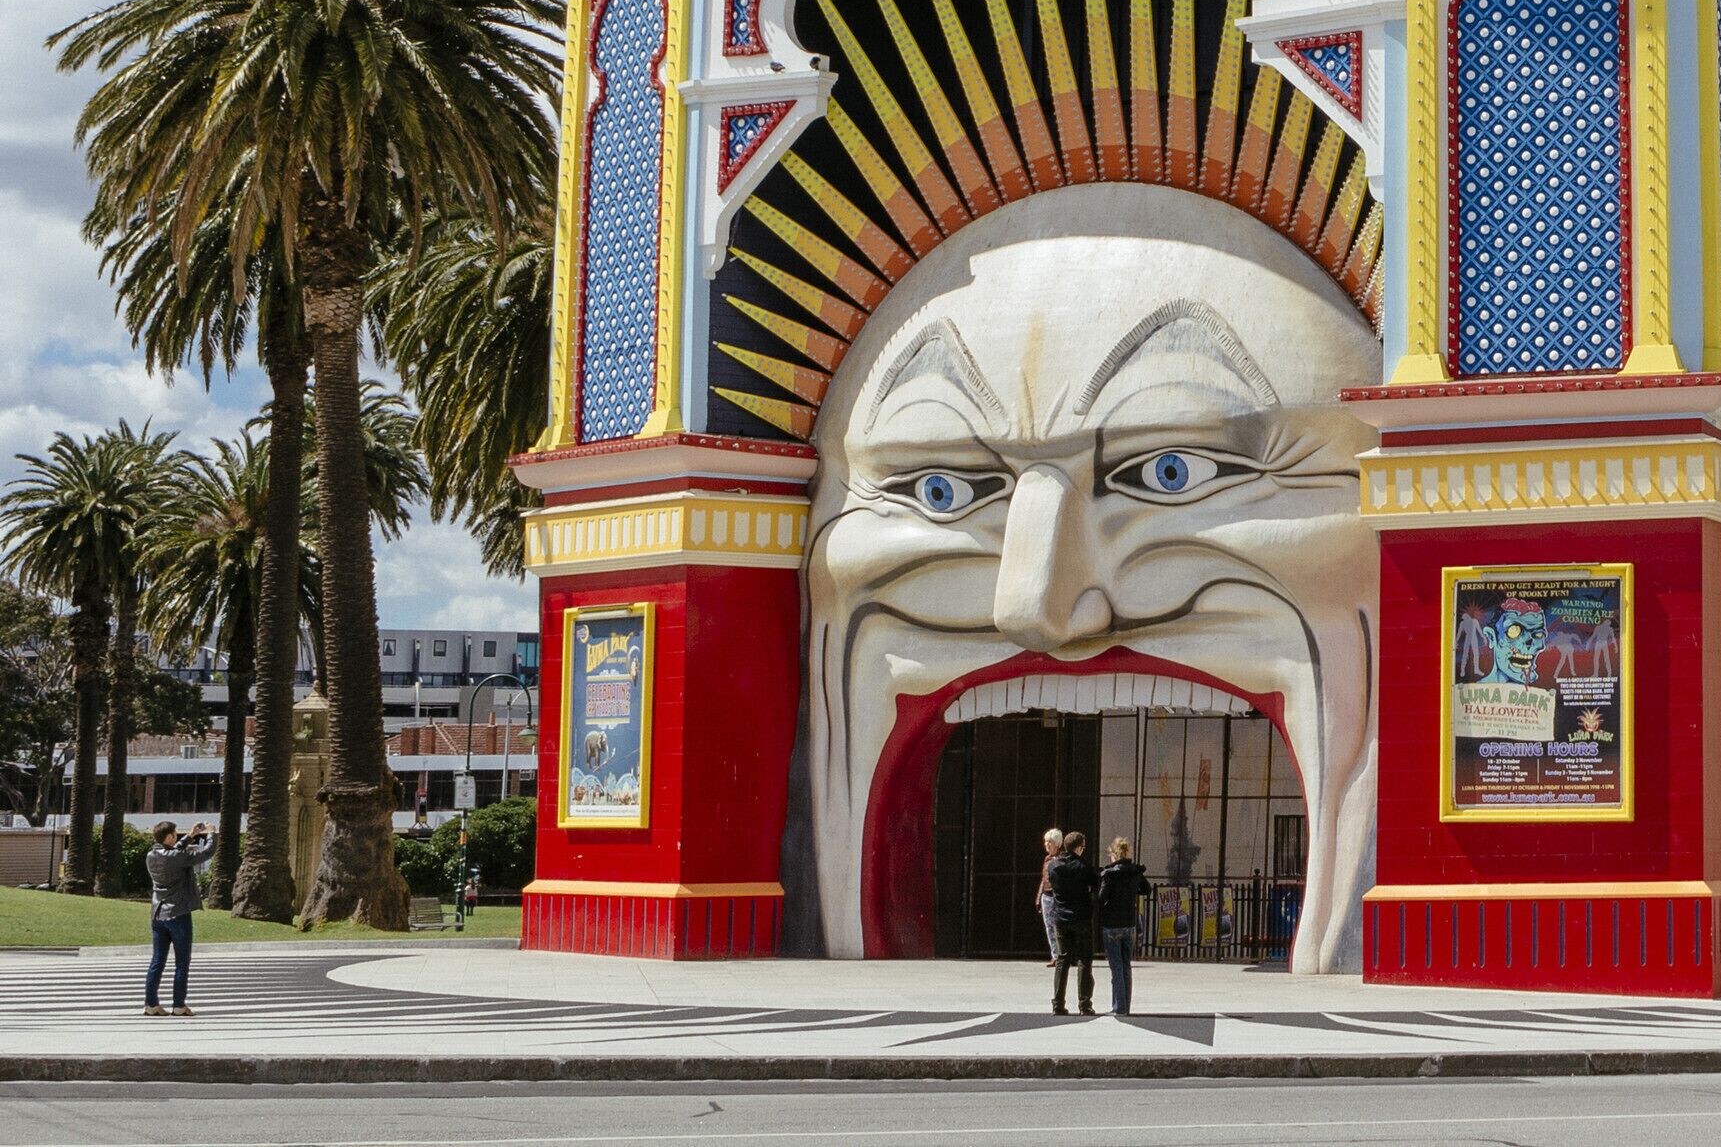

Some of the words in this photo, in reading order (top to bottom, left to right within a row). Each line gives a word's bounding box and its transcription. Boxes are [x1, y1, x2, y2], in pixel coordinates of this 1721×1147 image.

[1461, 583, 1485, 591] DRESS
[1551, 608, 1592, 616] ZOMBIES
[1595, 610, 1615, 618] ARE
[1459, 688, 1502, 706] LUNA
[1465, 705, 1539, 718] HALLOWEEN
[1479, 742, 1543, 757] OPENING
[1548, 741, 1599, 756] HOURS
